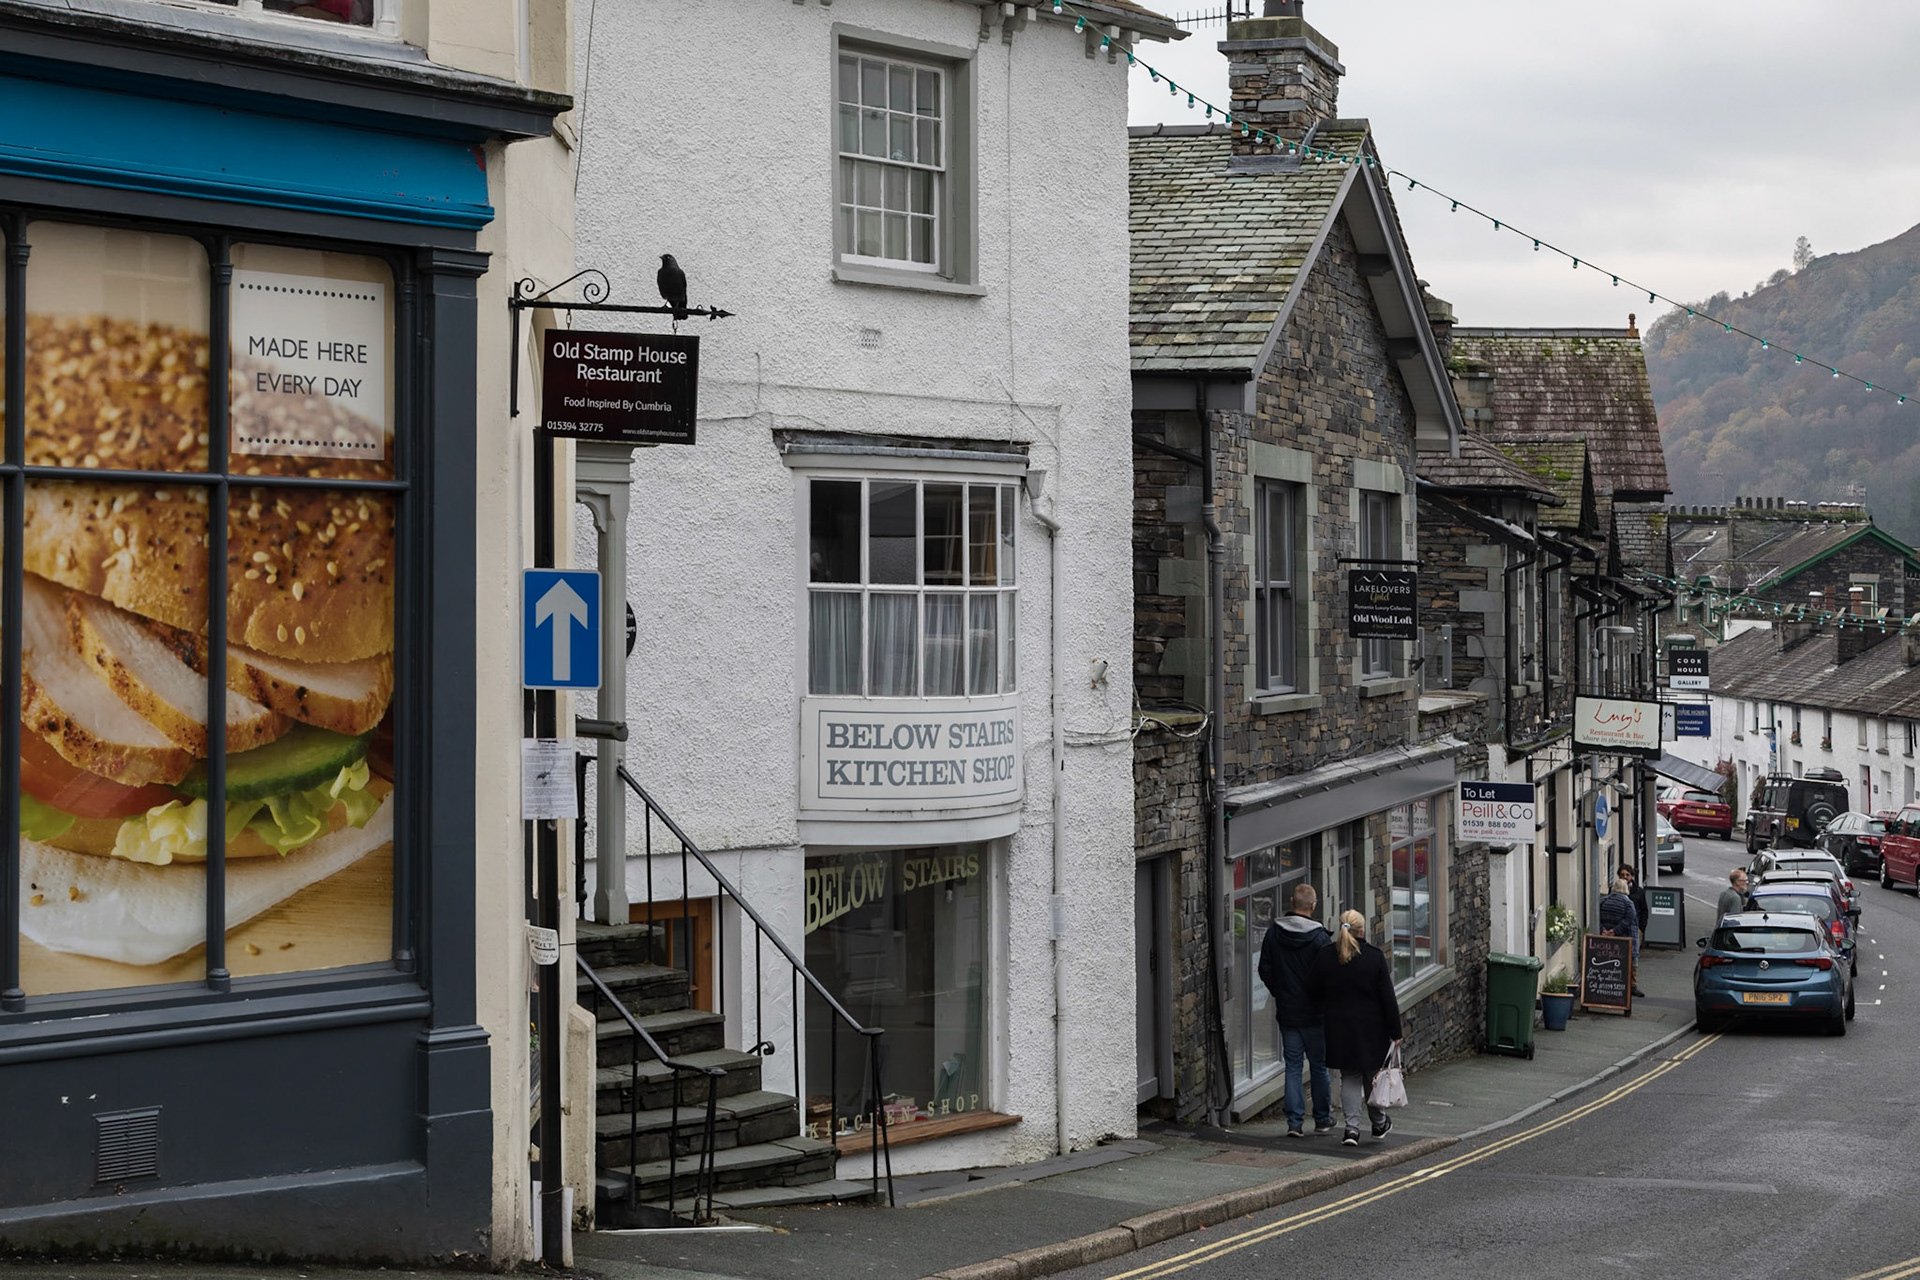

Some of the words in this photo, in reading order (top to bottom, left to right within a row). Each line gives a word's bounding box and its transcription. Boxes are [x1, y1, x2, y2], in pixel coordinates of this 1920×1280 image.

[249, 336, 308, 359] MADE
[317, 341, 367, 364] HERE
[552, 341, 580, 359] Old
[583, 343, 634, 366] Stamp
[638, 346, 688, 364] House
[576, 363, 662, 383] Restaurant
[256, 372, 317, 396] EVERY
[324, 377, 362, 398] DAY
[563, 396, 585, 408] Food
[586, 398, 621, 410] Inspired
[622, 400, 634, 412] By
[635, 401, 672, 412] Cumbria
[546, 421, 577, 431] 015394
[578, 422, 604, 432] 32775
[1354, 585, 1411, 594] LAKELOVERS
[1353, 614, 1370, 623] Old
[1371, 615, 1393, 624] Wool
[1394, 616, 1413, 625] Loft
[1594, 702, 1642, 732] Lucy's
[826, 723, 942, 750] BELOW
[948, 719, 1014, 749] STAIRS
[1590, 729, 1624, 738] Restaurant
[826, 759, 967, 786] KITCHEN
[972, 754, 1015, 784] SHOP
[1464, 788, 1476, 798] To
[1479, 788, 1495, 799] Let
[804, 863, 888, 936] BELOW
[903, 853, 979, 892] STAIRS
[927, 1094, 979, 1117] SHOP
